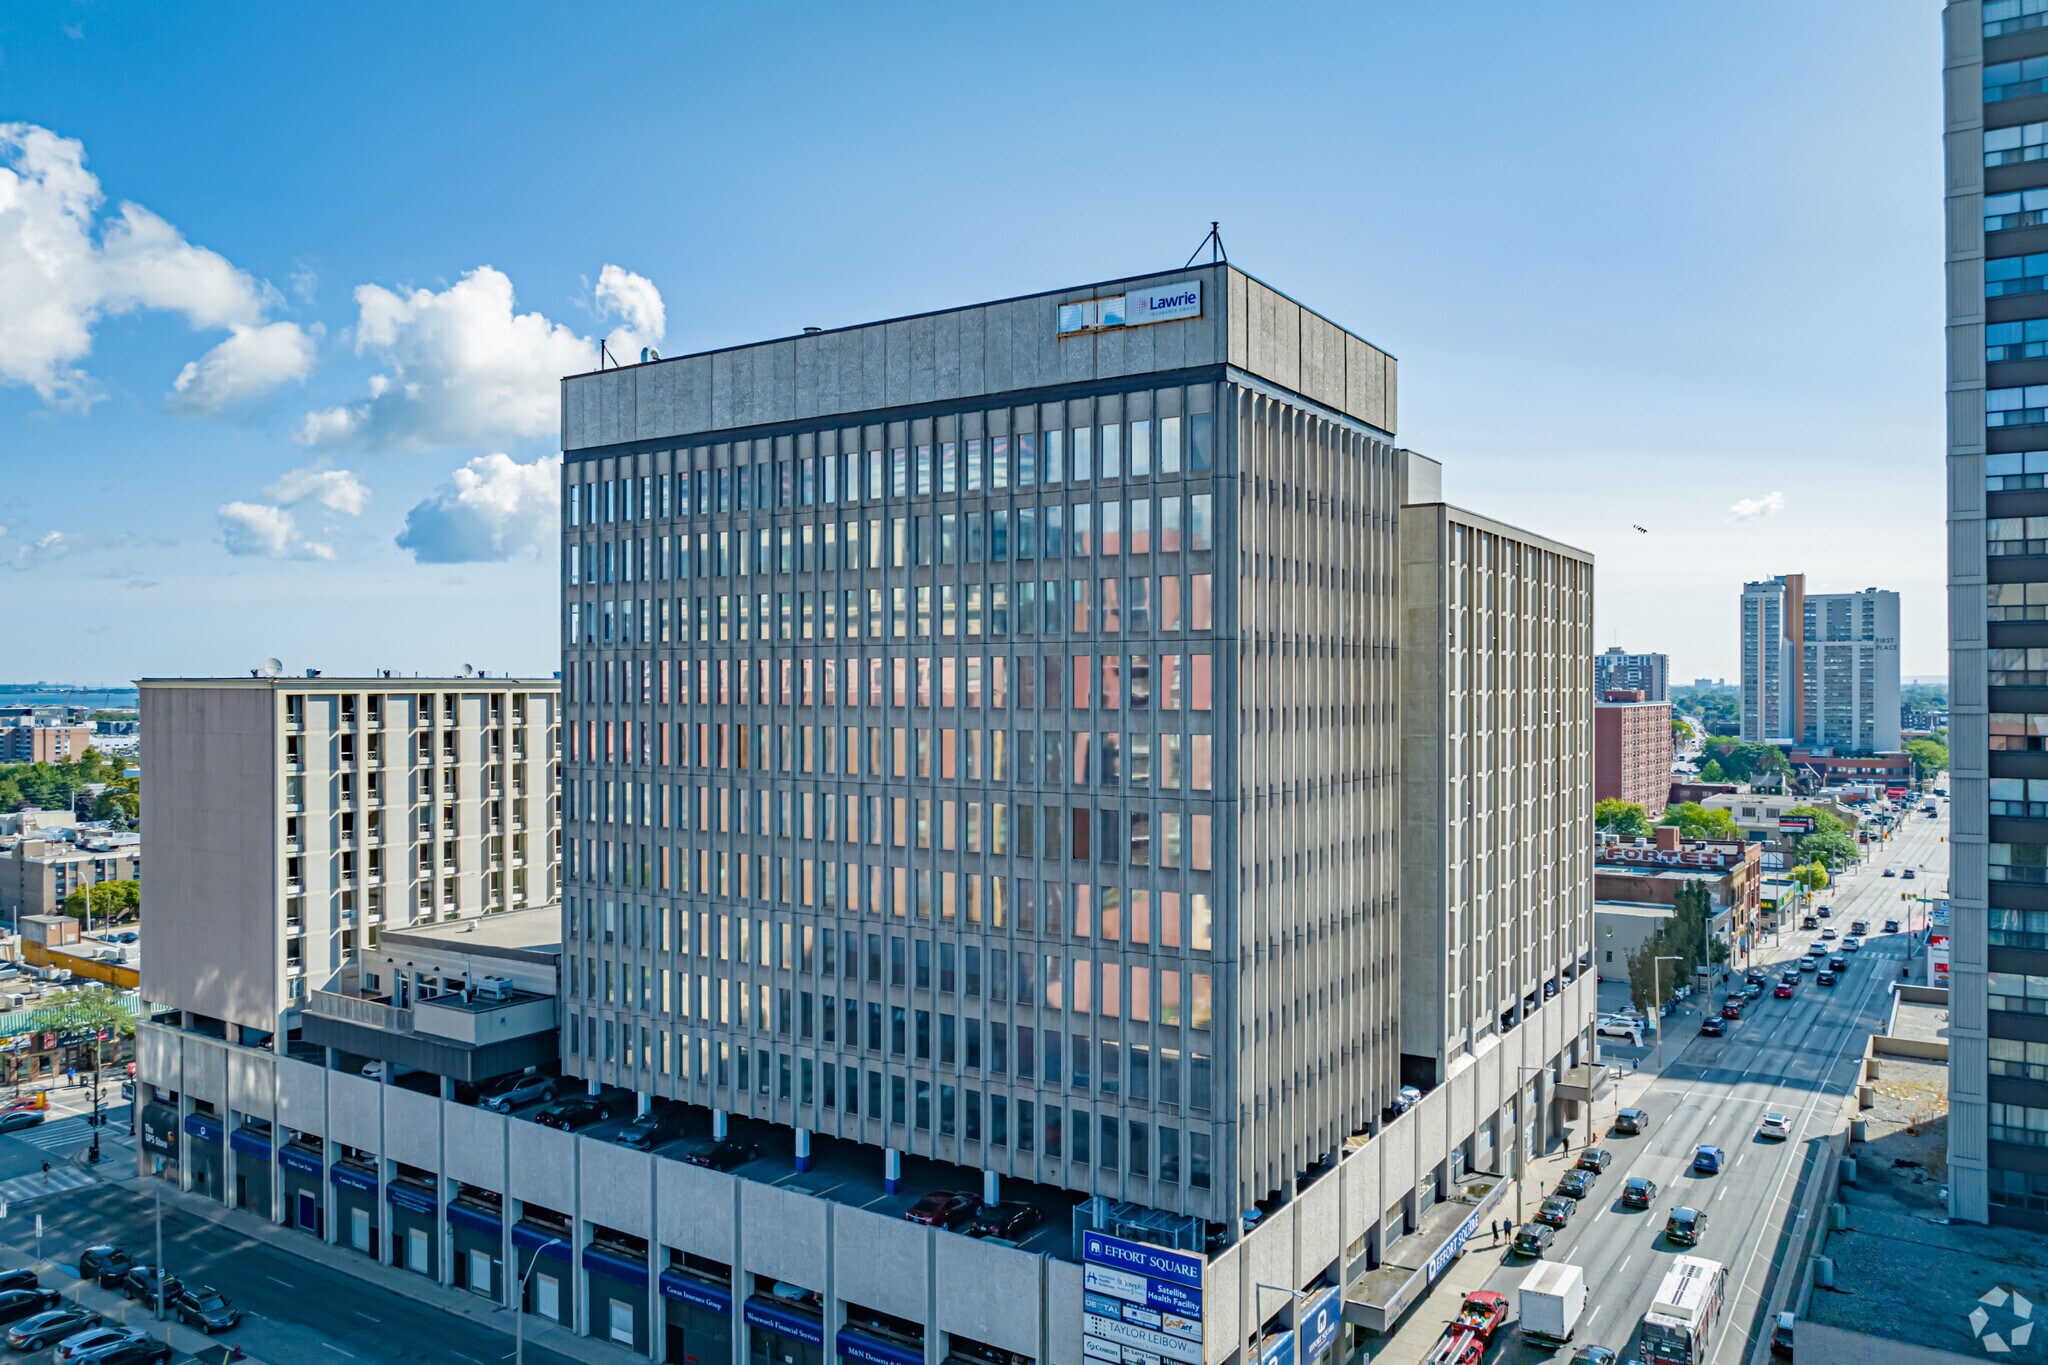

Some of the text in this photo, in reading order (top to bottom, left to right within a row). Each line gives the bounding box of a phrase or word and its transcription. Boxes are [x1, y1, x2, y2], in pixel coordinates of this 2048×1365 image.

[1150, 292, 1197, 310] Lawrie
[1150, 308, 1178, 317] INSURANCE
[144, 1123, 154, 1134] The
[145, 1133, 168, 1149] UPS Store
[1435, 1214, 1479, 1270] EFFORT SQUARE
[1104, 1244, 1198, 1278] EFFORT SQUARE
[666, 1285, 721, 1311] Cowan Insurance Group
[1157, 1285, 1187, 1299] Satellite
[1147, 1291, 1172, 1304] Health
[1173, 1298, 1200, 1312] Facility
[1138, 1306, 1157, 1314] LEASE
[1180, 1308, 1191, 1316] Next
[747, 1312, 820, 1342] Wentworth Financial Services
[1109, 1322, 1146, 1340] TAYLOR
[1148, 1333, 1187, 1352] LEIBOW
[848, 1346, 864, 1358] M&N
[1095, 1345, 1118, 1356] Cowan
[1131, 1349, 1145, 1358] Larry
